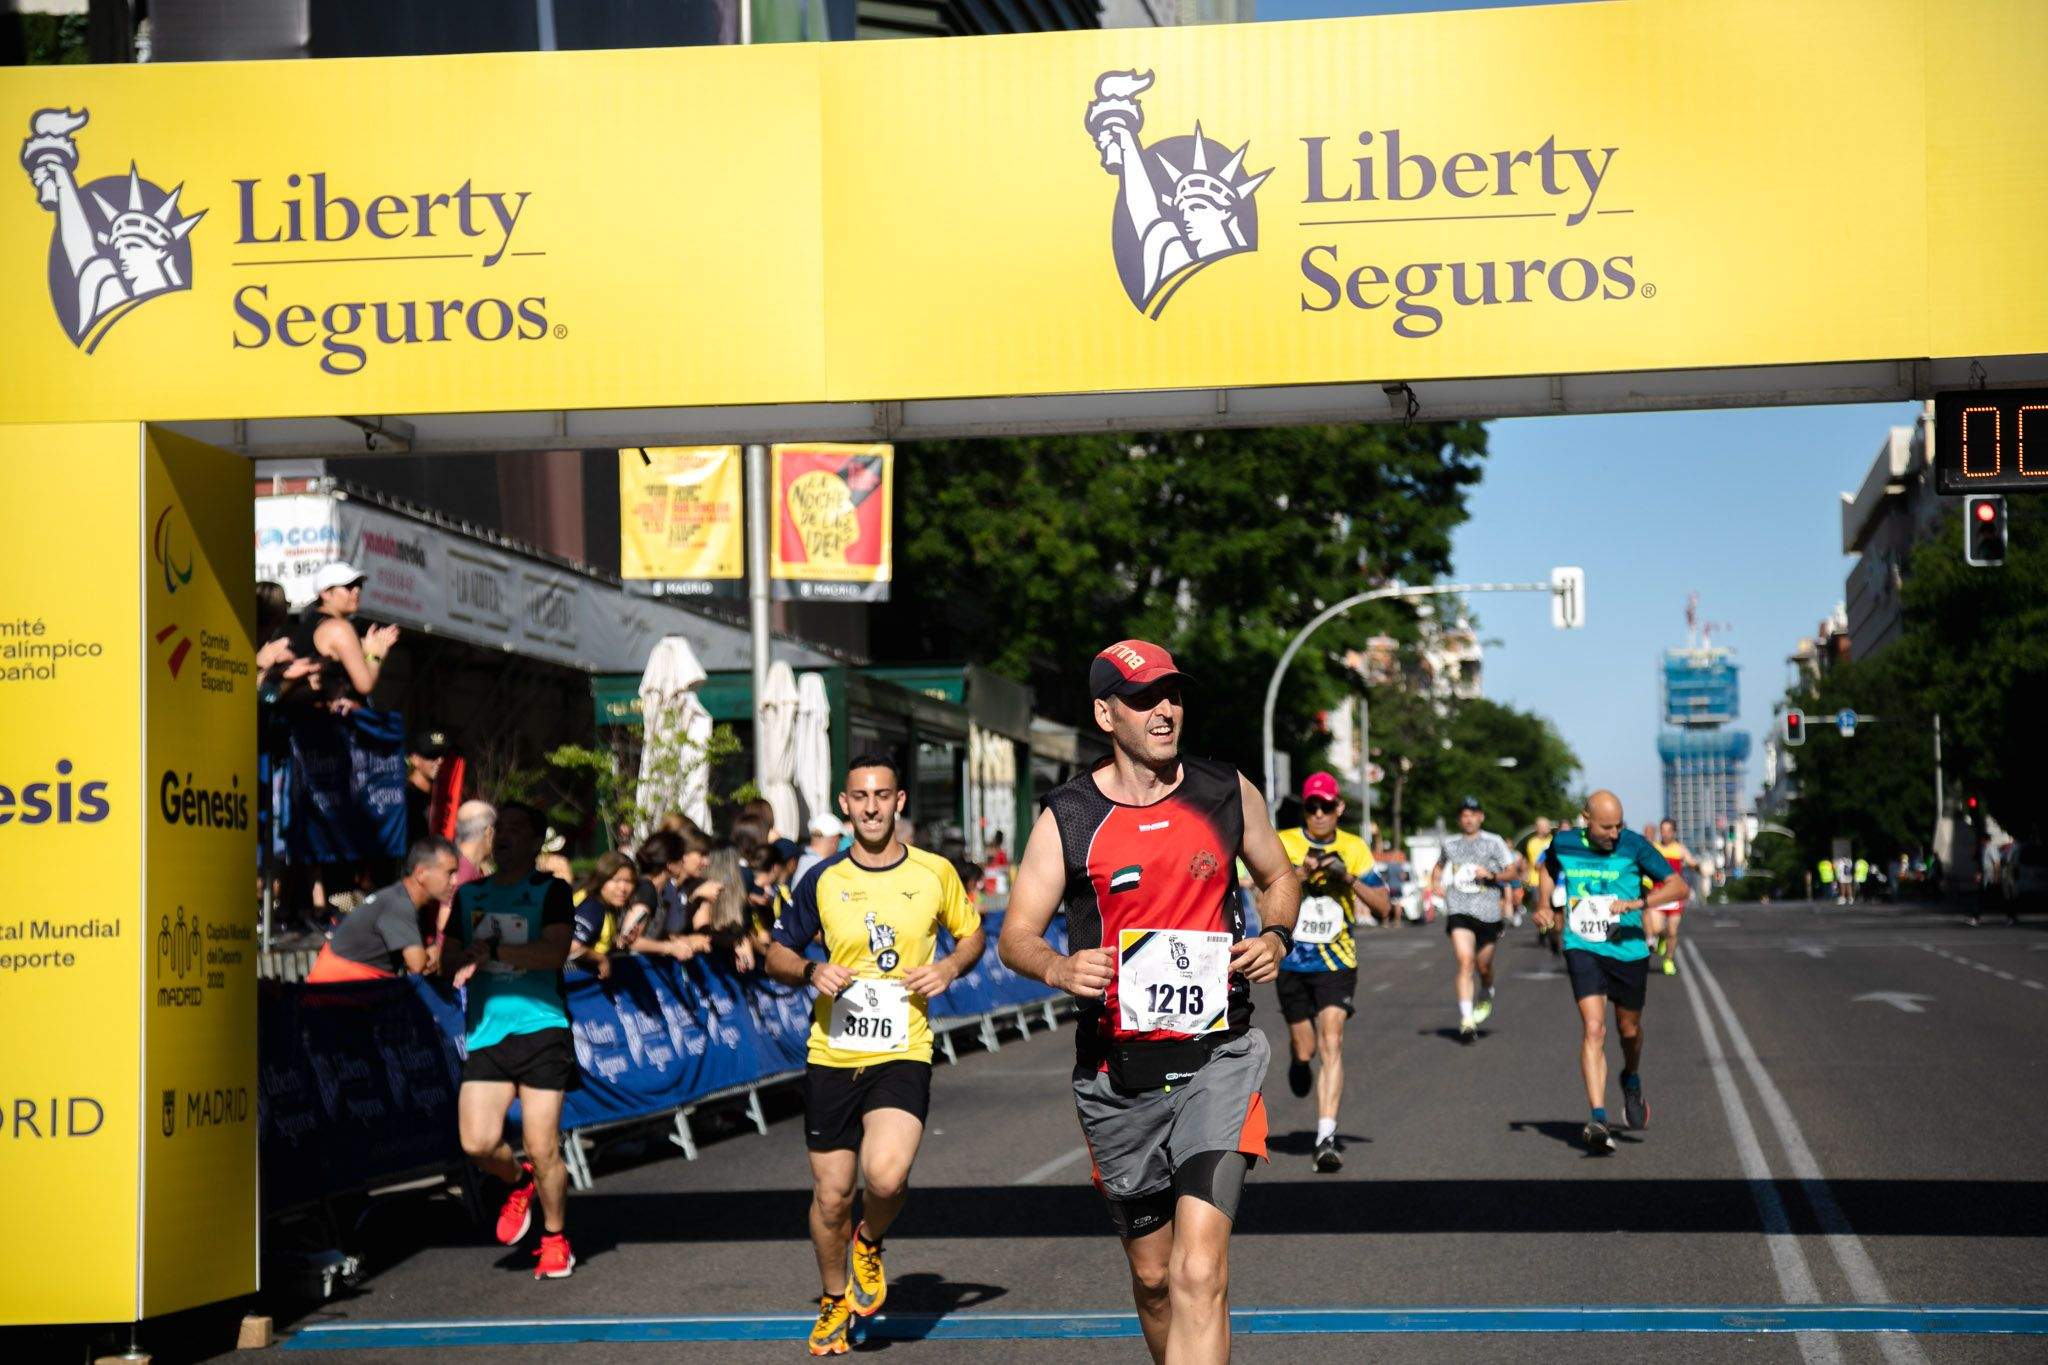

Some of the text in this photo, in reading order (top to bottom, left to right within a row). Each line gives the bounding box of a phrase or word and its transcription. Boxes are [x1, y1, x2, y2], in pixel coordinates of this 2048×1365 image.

[1299, 129, 1620, 227] Liberty
[232, 172, 532, 267] Liberty
[0, 640, 103, 662] alímpico
[160, 769, 248, 831] Génesis
[31, 918, 121, 939] Mundial
[1580, 920, 1609, 935] 3219
[880, 952, 897, 969] 13
[1145, 983, 1204, 1015] 1213
[845, 1014, 892, 1038] 3876
[0, 1097, 105, 1139] RID
[186, 1088, 248, 1128] MADRID
